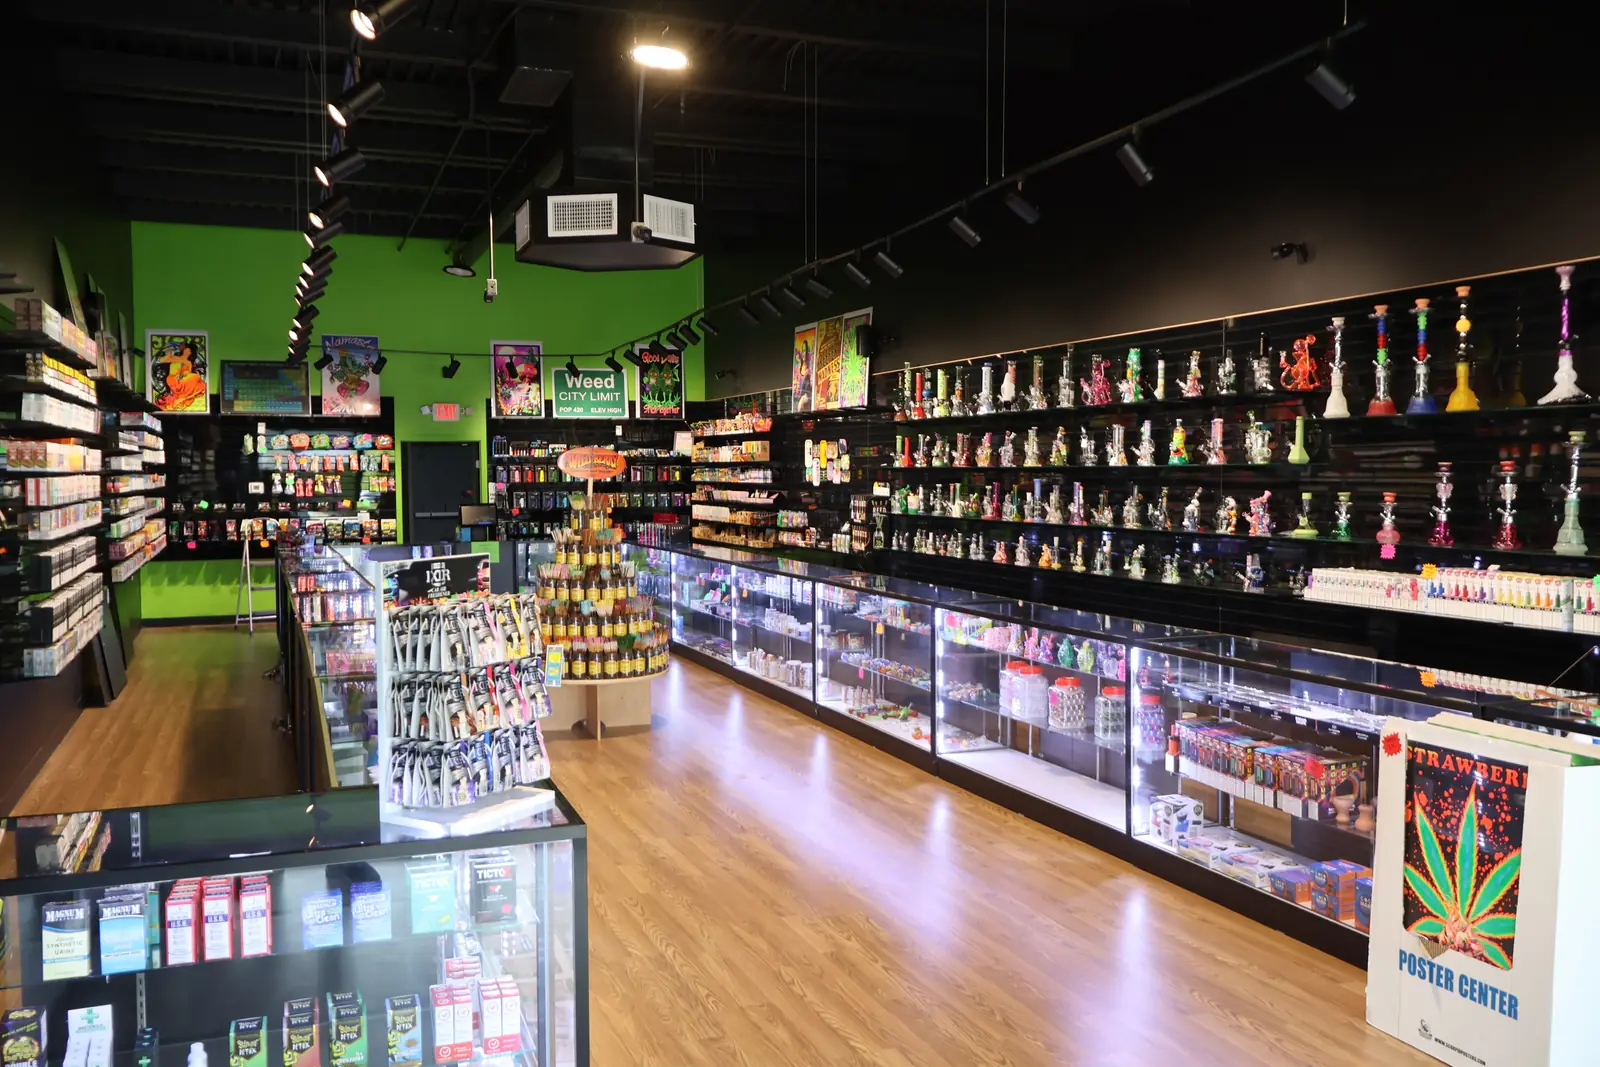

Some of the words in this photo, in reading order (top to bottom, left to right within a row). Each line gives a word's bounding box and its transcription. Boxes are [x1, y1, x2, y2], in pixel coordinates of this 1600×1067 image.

[565, 373, 615, 389] Weed
[559, 392, 585, 402] CITY
[590, 392, 621, 402] LIMIT
[436, 404, 457, 419] EXIT
[476, 866, 513, 880] TICTOX
[45, 908, 84, 922] MAGNUM
[102, 904, 141, 918] MAGNUM
[1398, 948, 1454, 993] POSTER
[1458, 974, 1518, 1021] CENTER
